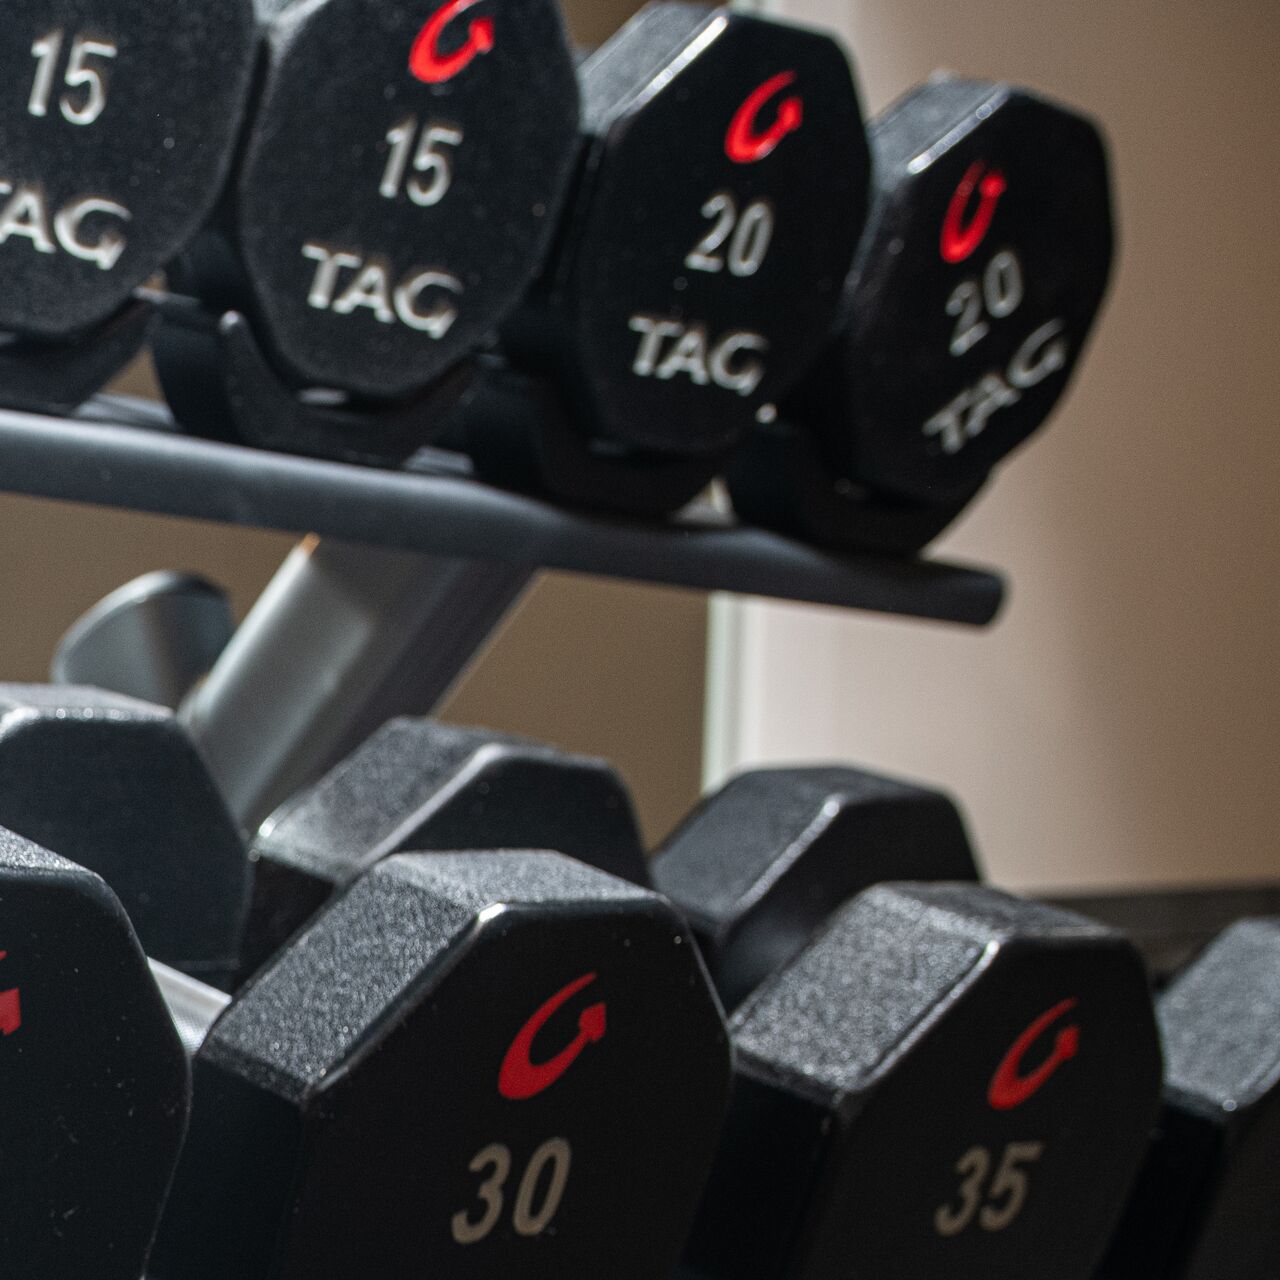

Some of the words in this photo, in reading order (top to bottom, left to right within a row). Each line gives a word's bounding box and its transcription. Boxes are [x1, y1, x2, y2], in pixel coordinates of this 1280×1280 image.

[26, 27, 119, 126] 15
[378, 115, 465, 208] 15
[684, 189, 775, 278] 20
[300, 242, 465, 340] TAG
[944, 249, 1024, 358] 20
[628, 314, 769, 397] TAG
[922, 318, 1070, 455] TAG
[450, 1136, 574, 1247] 30
[933, 1140, 1045, 1237] 35
